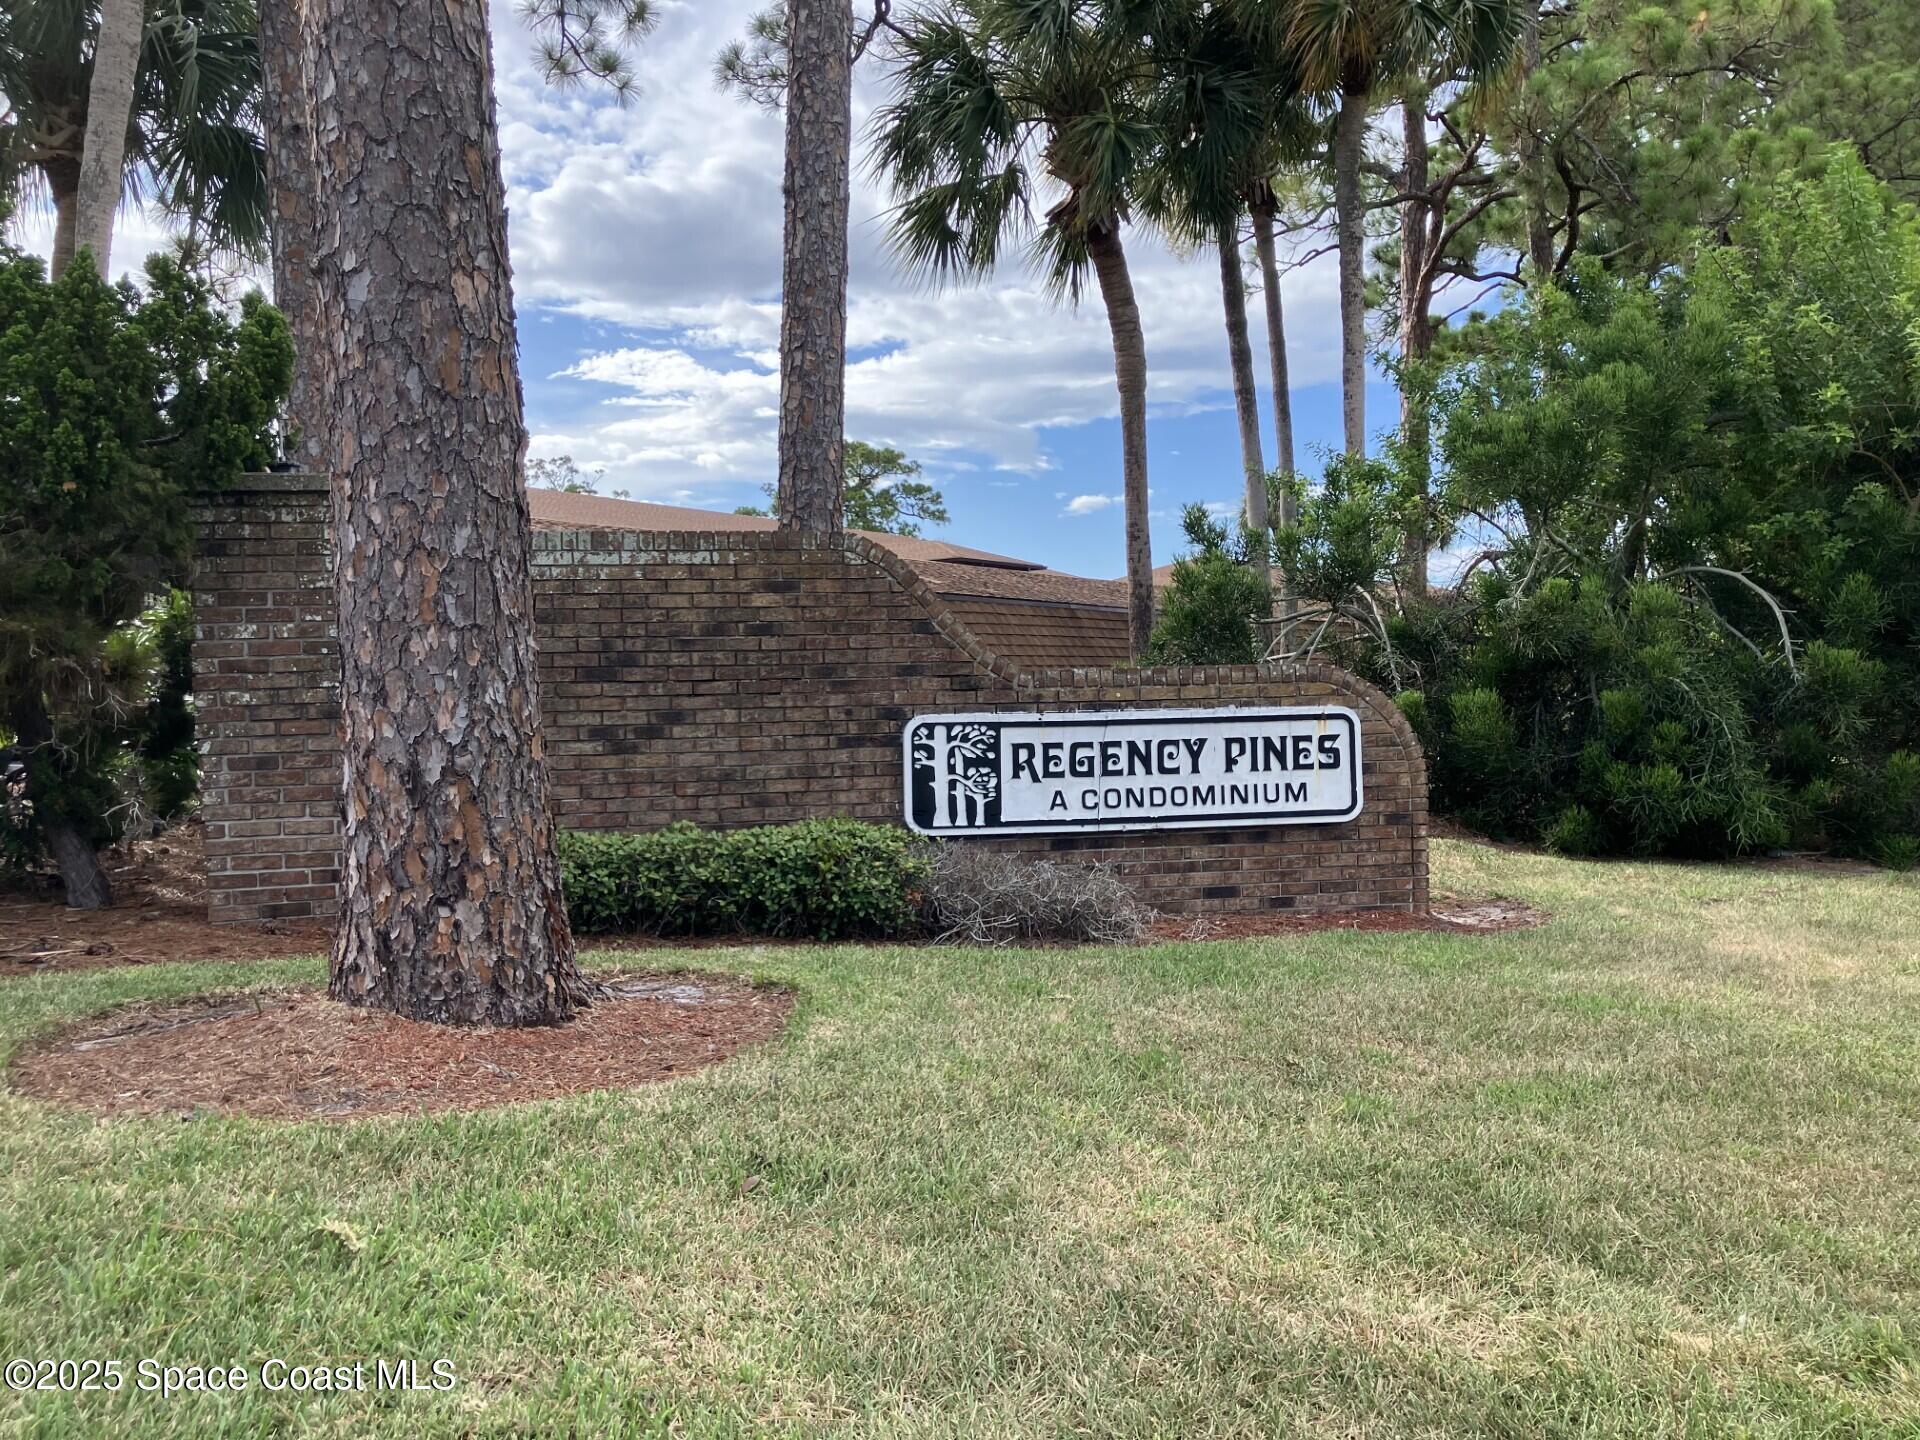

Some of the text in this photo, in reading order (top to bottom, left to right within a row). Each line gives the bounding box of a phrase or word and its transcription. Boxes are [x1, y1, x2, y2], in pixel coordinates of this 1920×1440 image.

[1011, 734, 1341, 783] REGENCY PINES
[1049, 782, 1308, 811] A CONDOMINIUM
